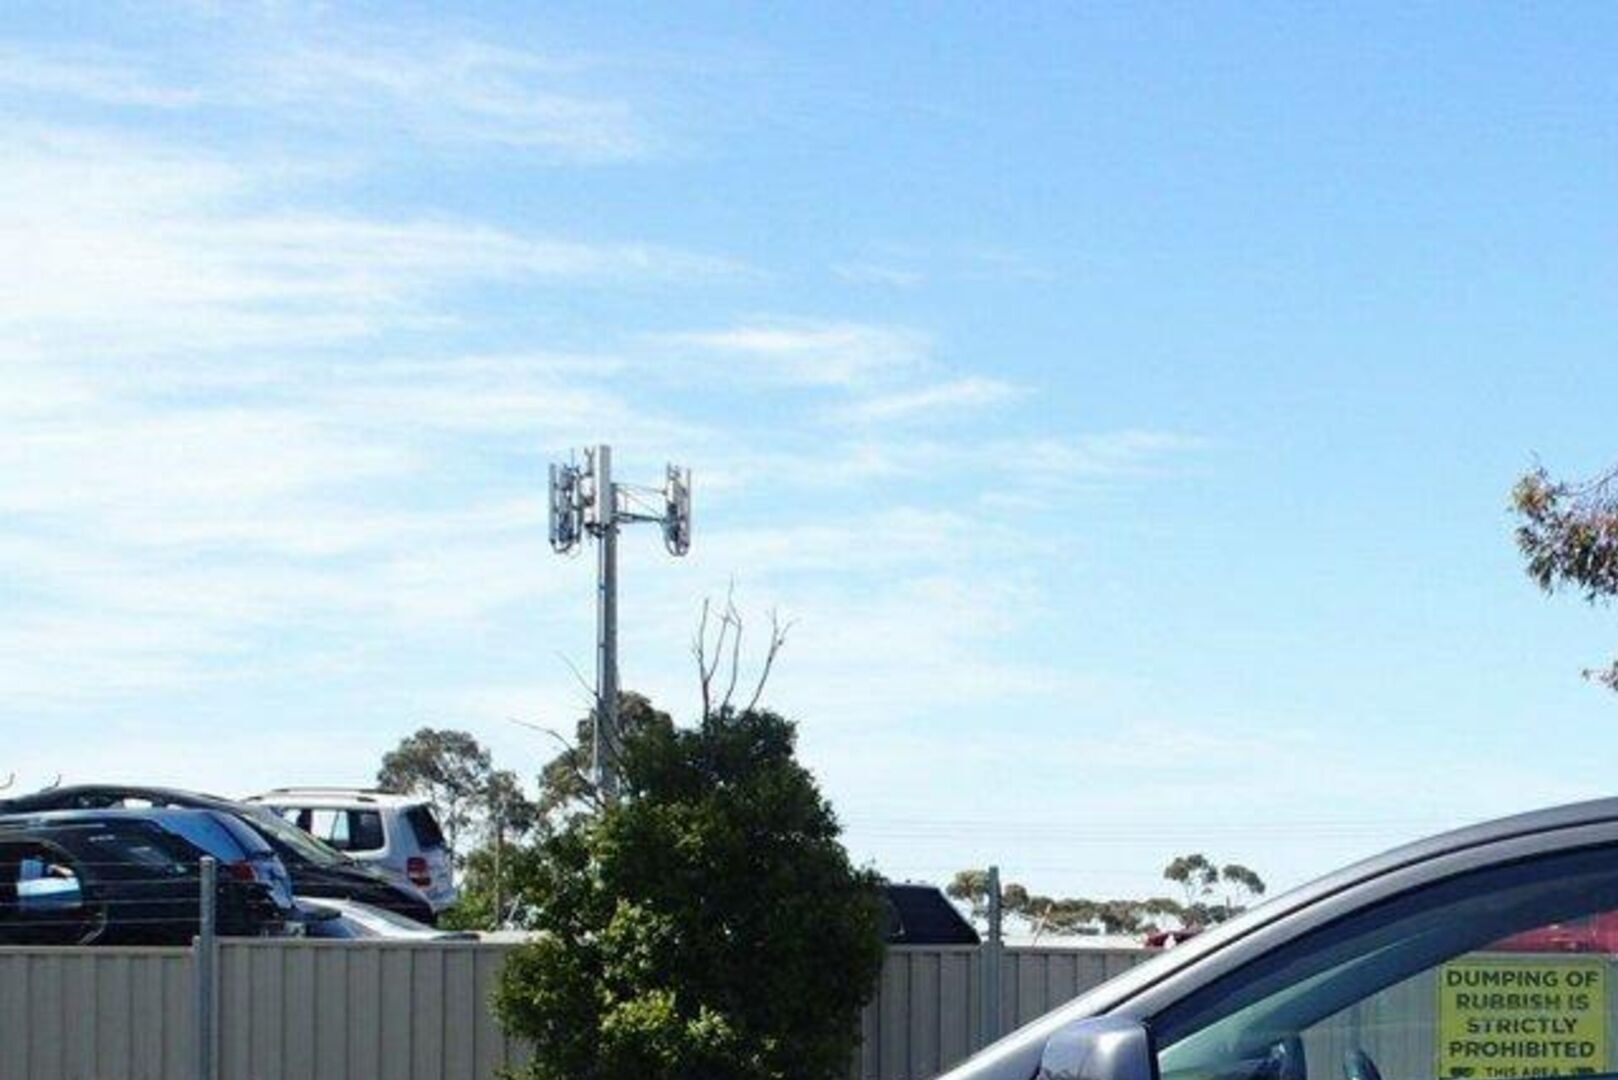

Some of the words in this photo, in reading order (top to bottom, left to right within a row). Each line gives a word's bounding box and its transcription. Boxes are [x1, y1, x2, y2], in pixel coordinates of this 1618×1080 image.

[1446, 970, 1558, 988] DUMPING
[1565, 970, 1599, 988] OF
[1456, 993, 1562, 1011] RUBBISH
[1568, 993, 1590, 1011] IS
[1466, 1017, 1578, 1034] STRICTLY
[1448, 1040, 1595, 1058] PROHIBITED
[1485, 1066, 1516, 1078] THIS
